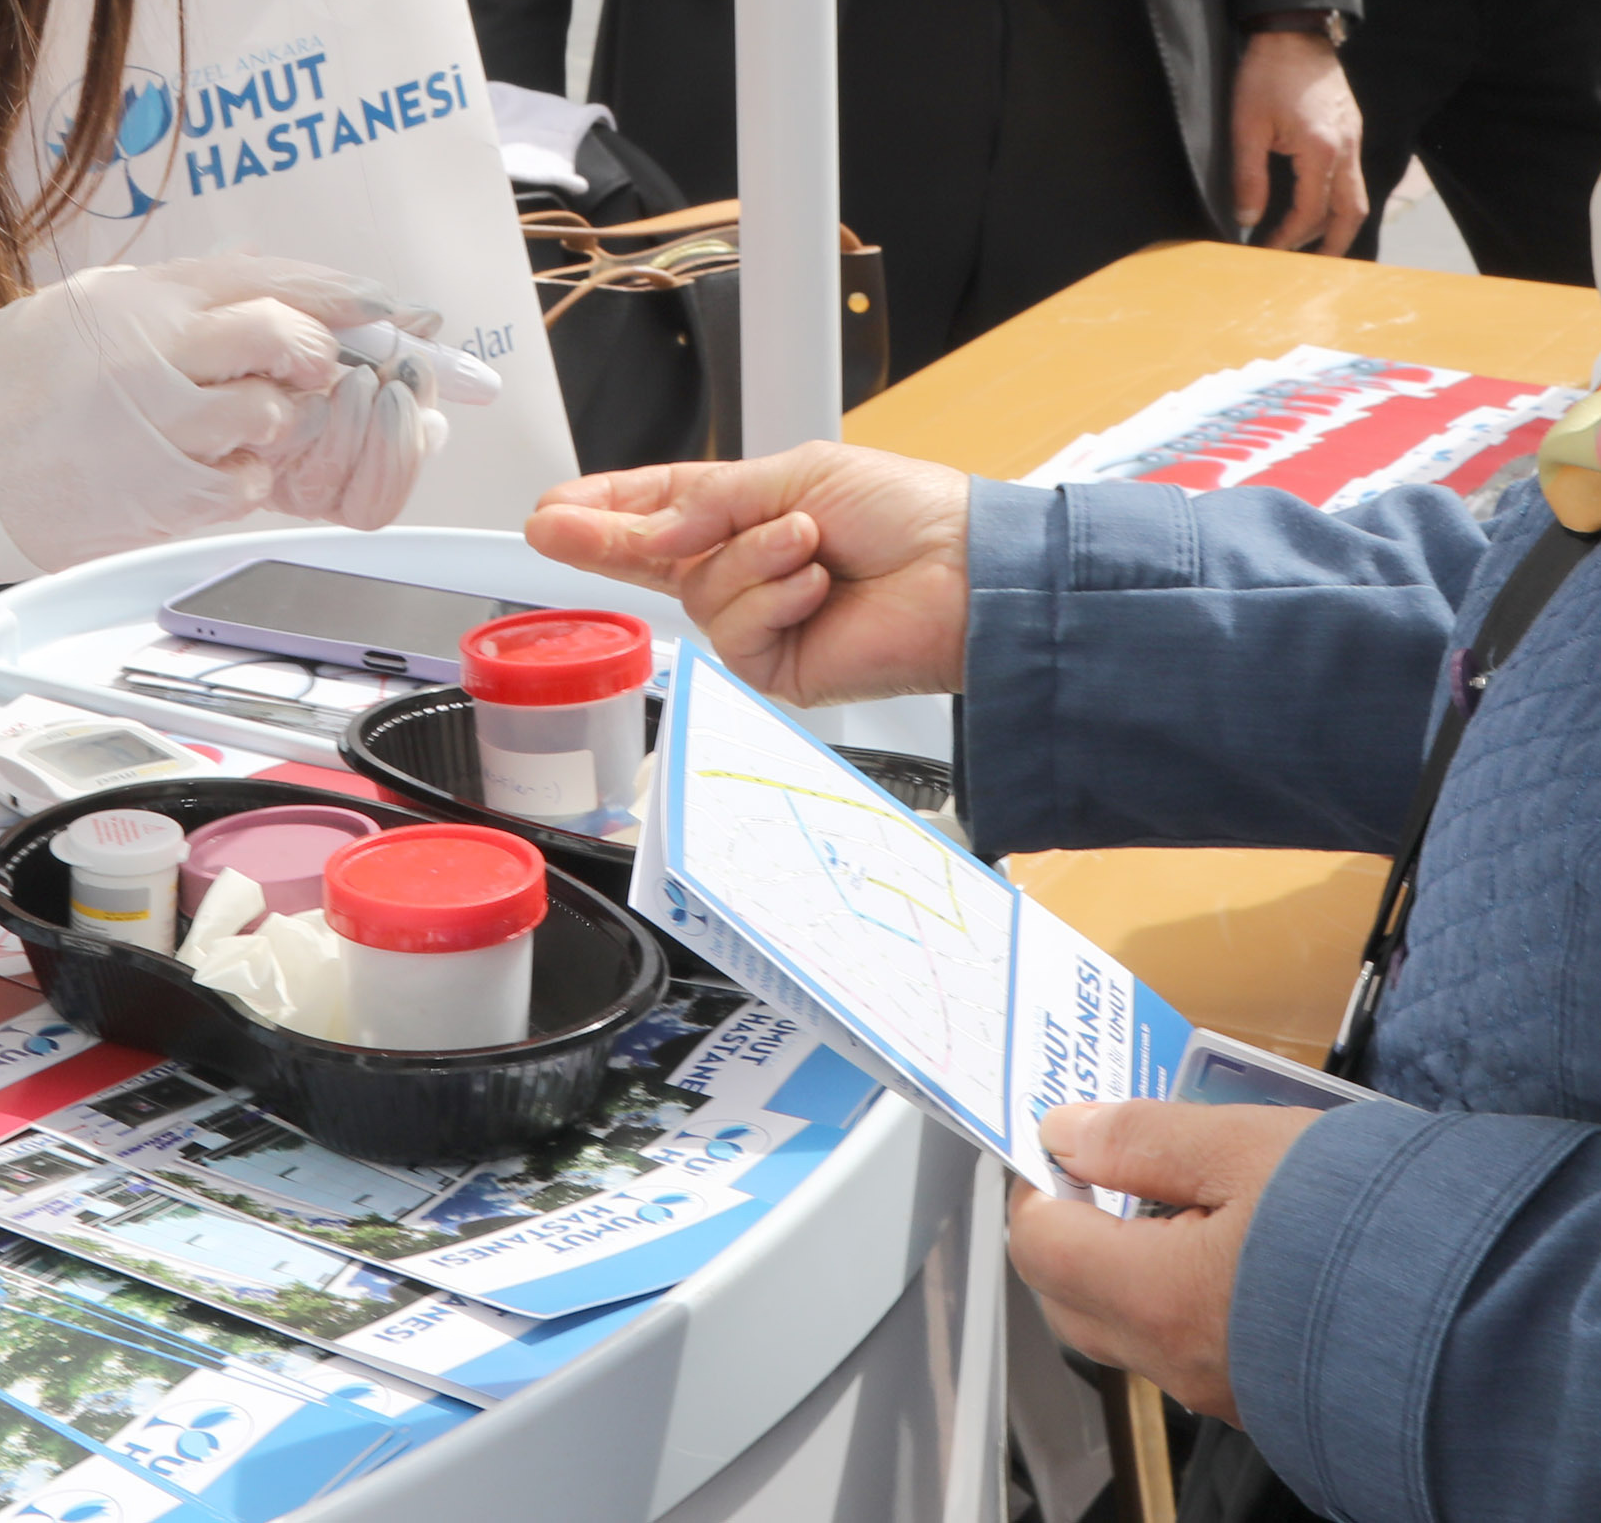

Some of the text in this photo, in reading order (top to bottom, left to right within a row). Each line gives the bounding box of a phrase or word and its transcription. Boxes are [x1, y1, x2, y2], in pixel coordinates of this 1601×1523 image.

[235, 33, 326, 75] ANKARA
[181, 51, 327, 140] UMUT
[185, 63, 469, 198] HASTANESİ
[677, 1012, 774, 1094] HASTANE
[740, 1018, 800, 1067] UMUT
[1075, 953, 1102, 1103] ASTANESİ
[1108, 979, 1127, 1045] UMUT
[1042, 1010, 1070, 1107] UMUT
[548, 1214, 642, 1255] UMUT
